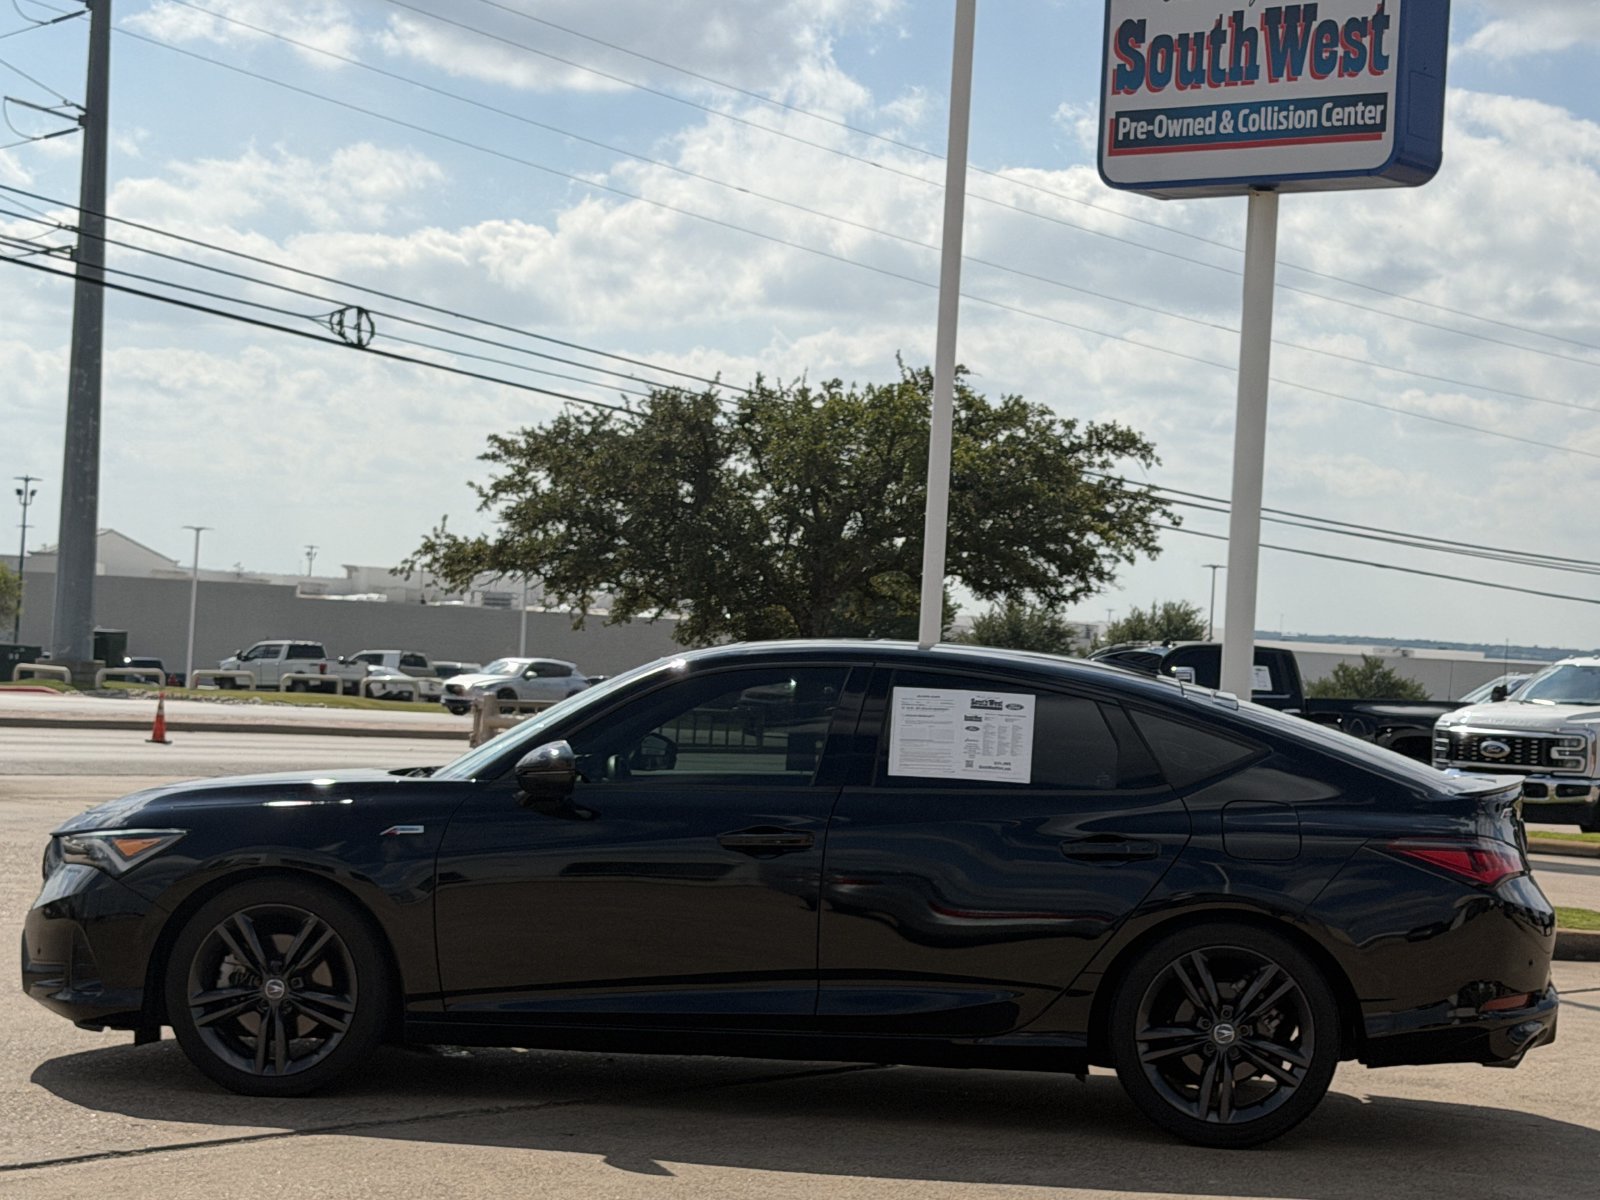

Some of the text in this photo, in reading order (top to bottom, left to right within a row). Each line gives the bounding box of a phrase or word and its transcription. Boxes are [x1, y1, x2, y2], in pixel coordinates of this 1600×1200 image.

[1111, 0, 1391, 95] SouthWest
[1117, 101, 1385, 141] Pre-Owned & Collision Center
